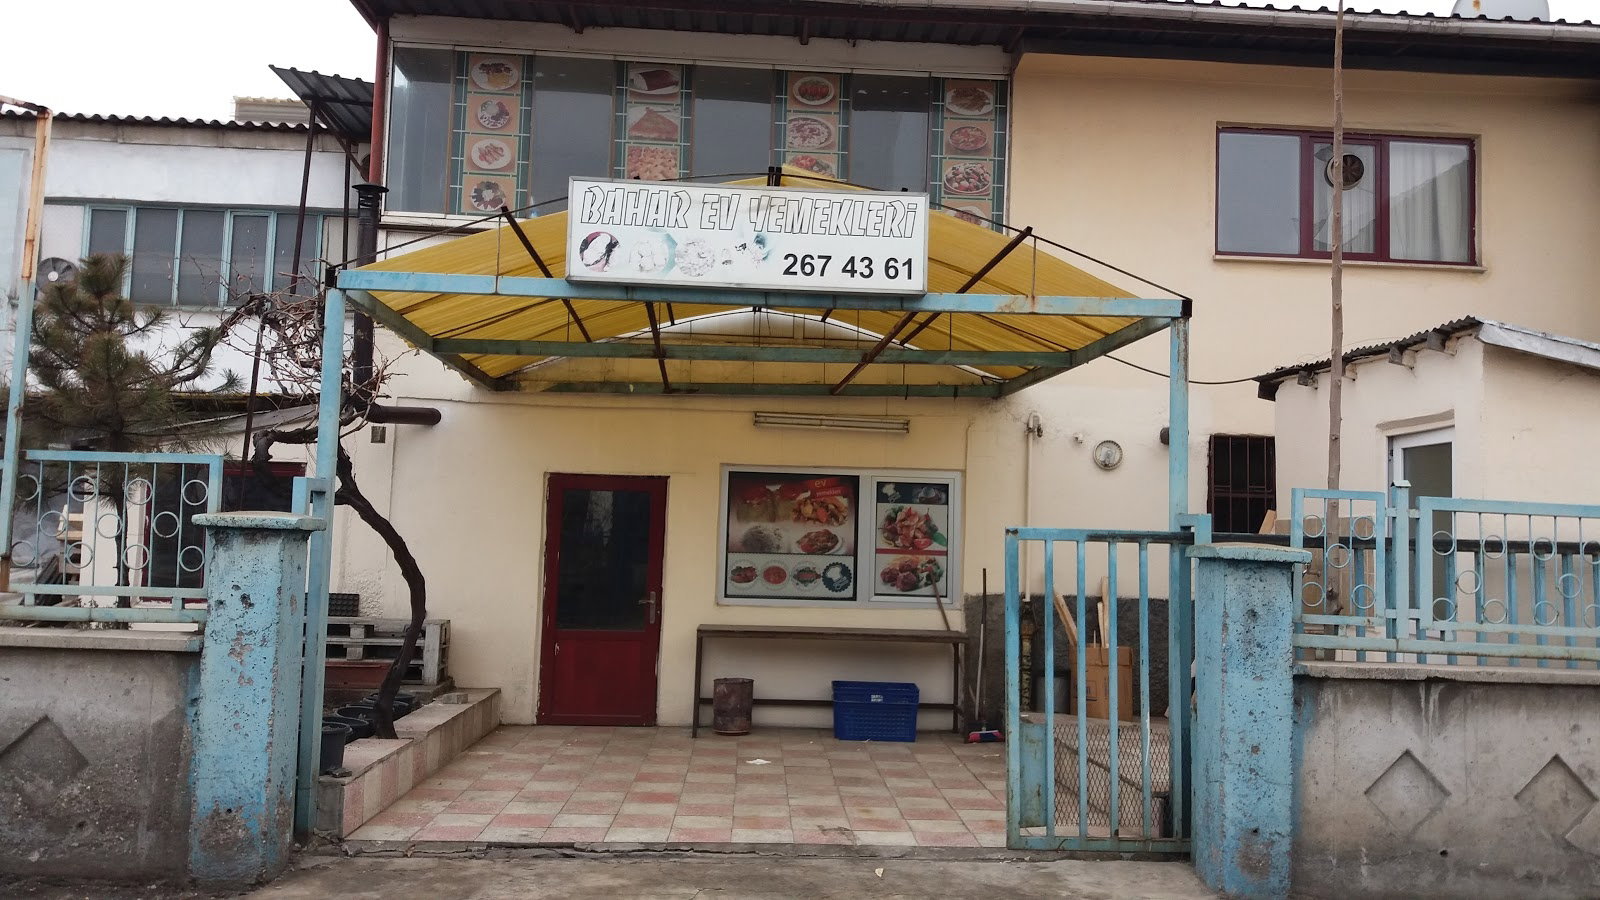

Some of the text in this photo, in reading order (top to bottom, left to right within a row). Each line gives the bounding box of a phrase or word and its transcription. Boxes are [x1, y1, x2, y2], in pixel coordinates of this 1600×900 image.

[580, 185, 692, 229] BAHAR
[699, 193, 742, 231] EV
[782, 253, 913, 280] 267 43 61
[814, 479, 827, 488] ev
